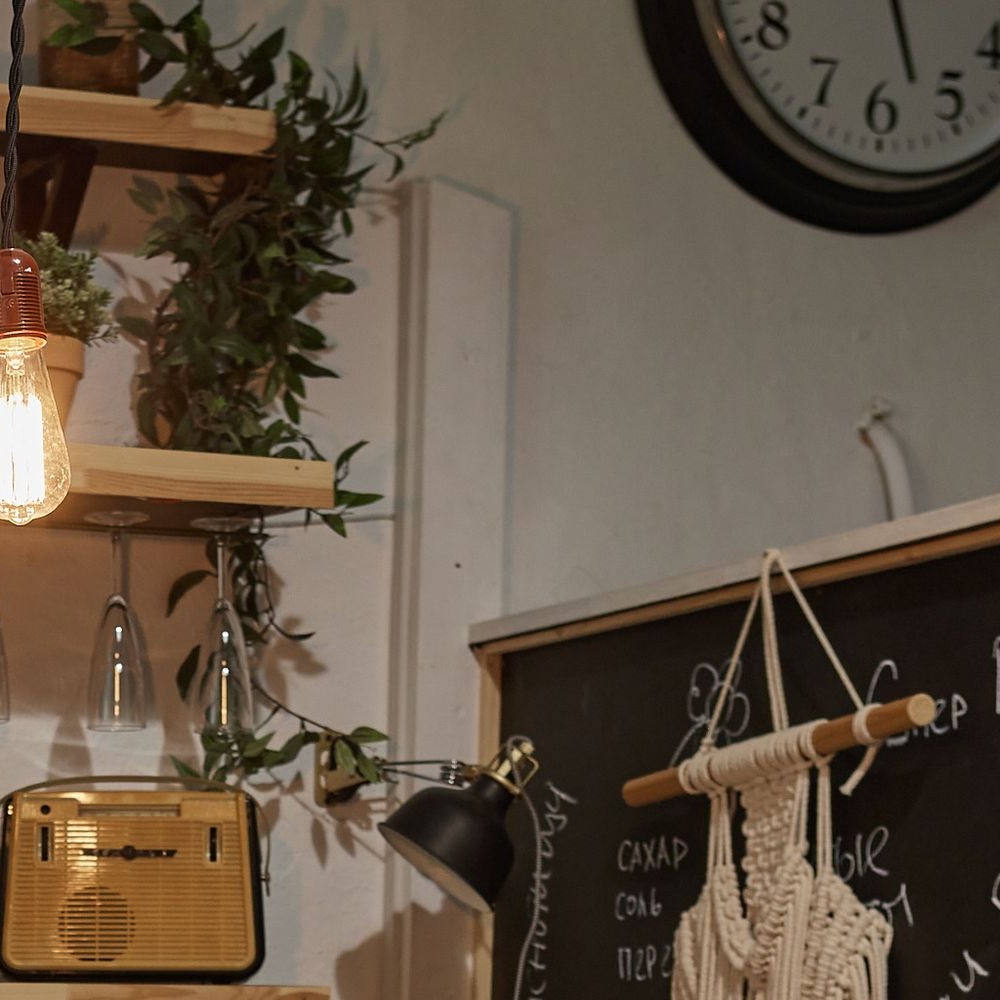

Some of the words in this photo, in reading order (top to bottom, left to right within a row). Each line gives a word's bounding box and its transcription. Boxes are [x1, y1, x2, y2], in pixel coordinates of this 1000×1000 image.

[757, 1, 790, 49] 8
[809, 57, 838, 106] 7
[935, 71, 963, 121] 5
[866, 81, 897, 135] 6
